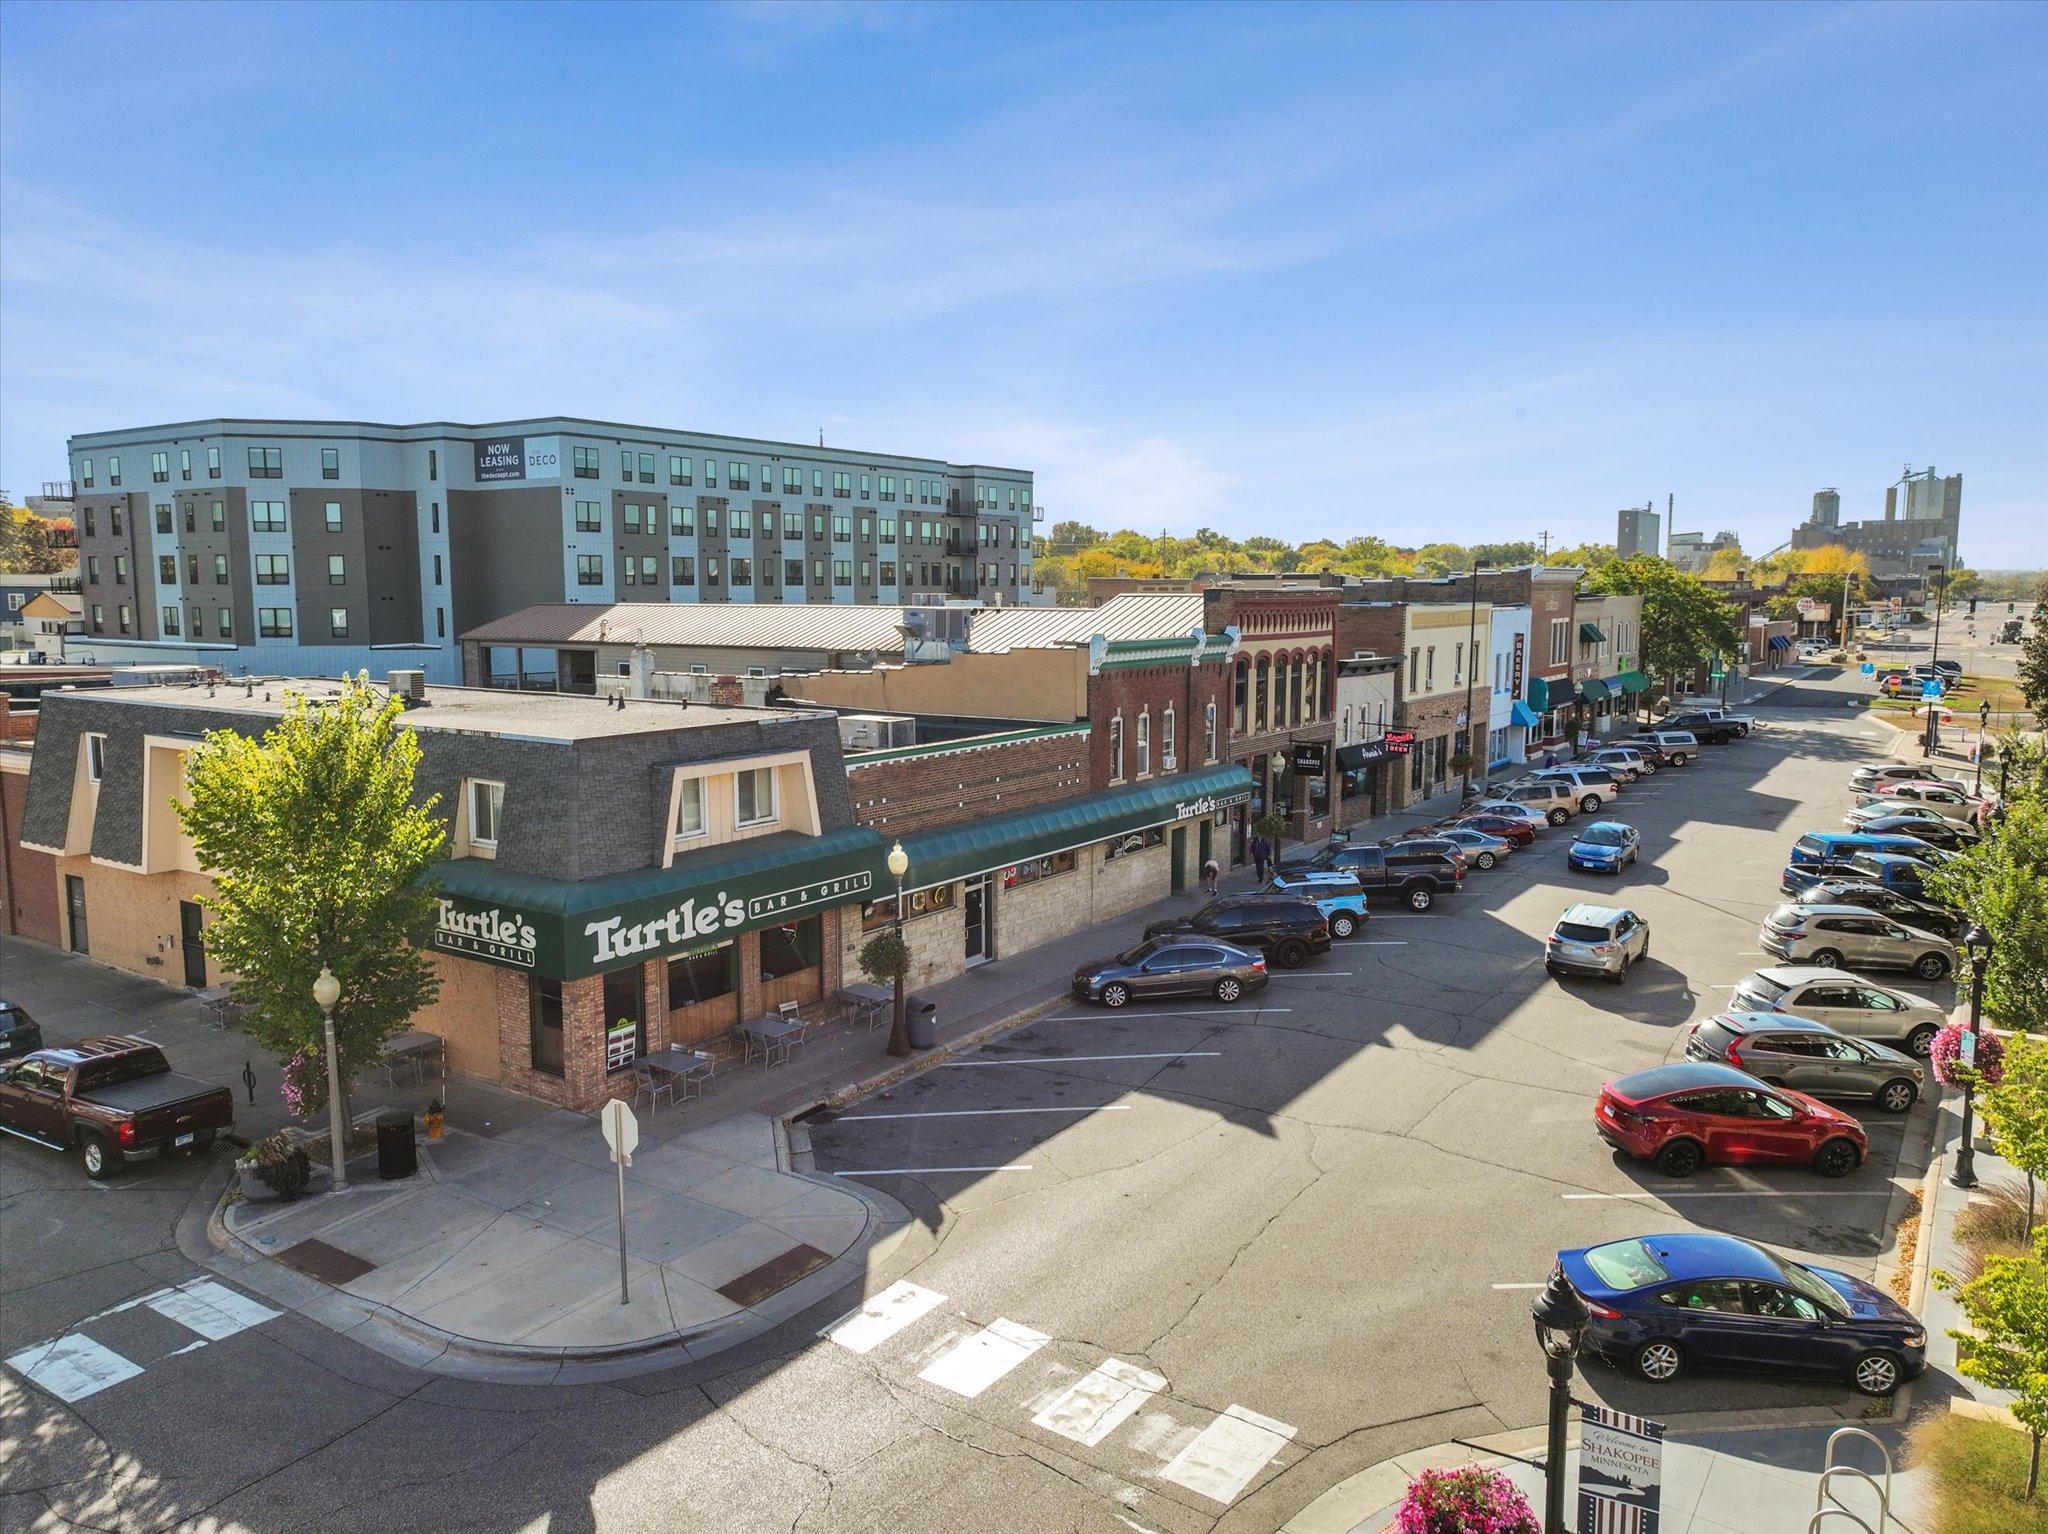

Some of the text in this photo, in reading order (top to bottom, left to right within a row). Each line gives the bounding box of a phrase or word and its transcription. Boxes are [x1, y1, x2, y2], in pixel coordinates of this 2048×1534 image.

[480, 455, 519, 467] LEASING
[488, 444, 510, 455] NOW
[529, 454, 557, 466] DECO
[1514, 642, 1522, 685] BAKERY
[1175, 796, 1216, 820] Turtle's
[435, 897, 537, 949] Turtle's
[585, 892, 745, 963] Turtle's
[754, 896, 787, 913] BAR
[800, 891, 807, 901] &
[820, 873, 869, 896] GRILL
[439, 933, 531, 963] BAR & GRILL
[1593, 1431, 1637, 1449] Welcome
[1582, 1438, 1660, 1469] SHAKOPEE
[1591, 1455, 1649, 1476] MINNESOTA
